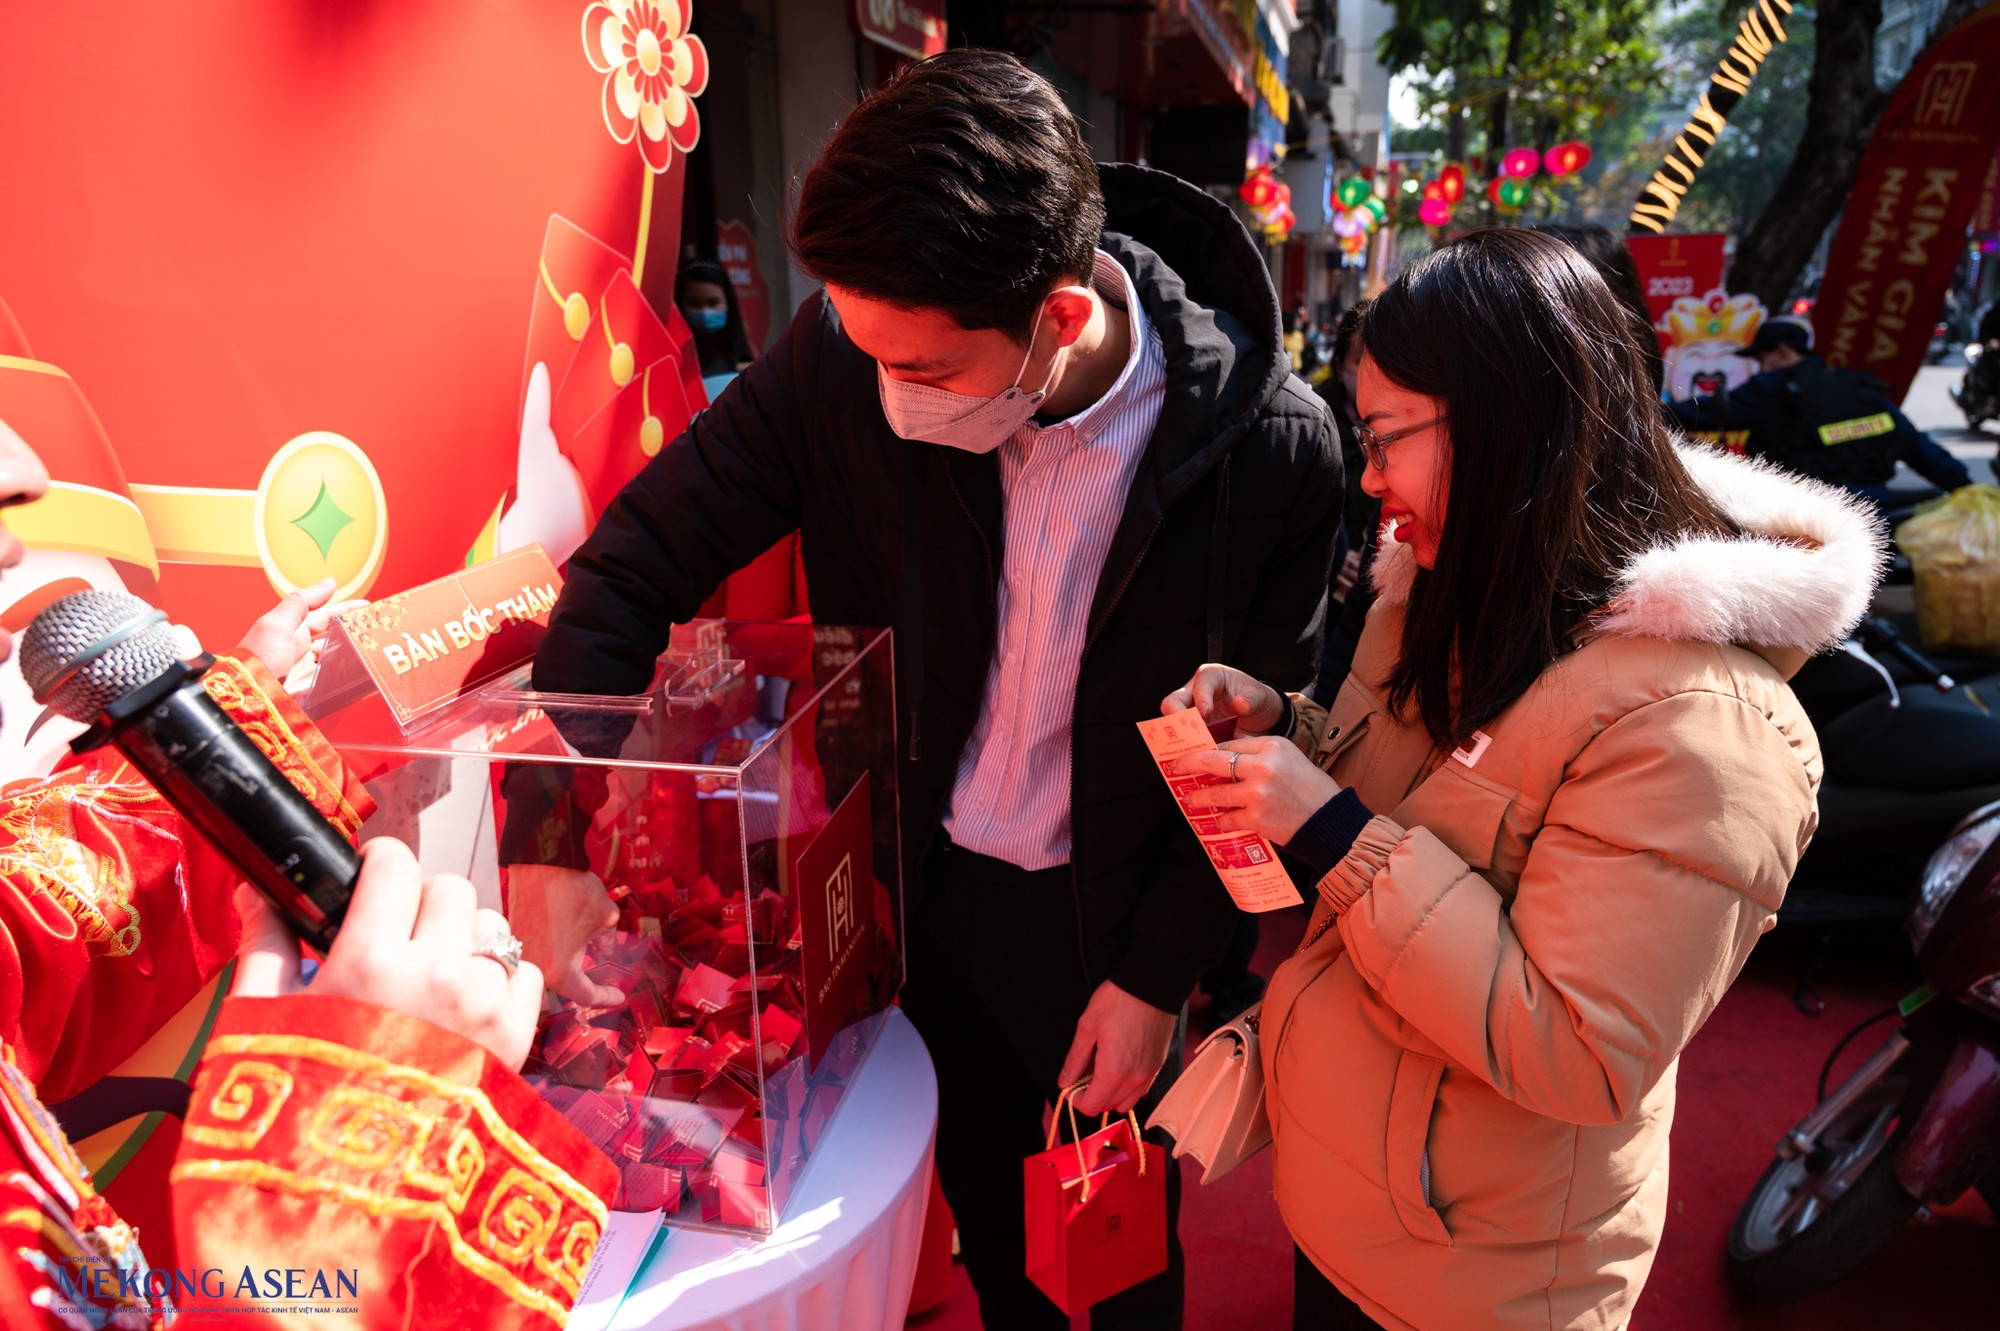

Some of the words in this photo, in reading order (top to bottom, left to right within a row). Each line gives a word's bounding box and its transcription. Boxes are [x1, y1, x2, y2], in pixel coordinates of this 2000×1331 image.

[1900, 169, 1958, 266] KIM
[1647, 276, 1694, 296] 2023
[1867, 280, 1914, 363] GIA
[383, 629, 450, 675] BÀN
[445, 604, 502, 650] BỐC
[496, 583, 558, 627] THĂM
